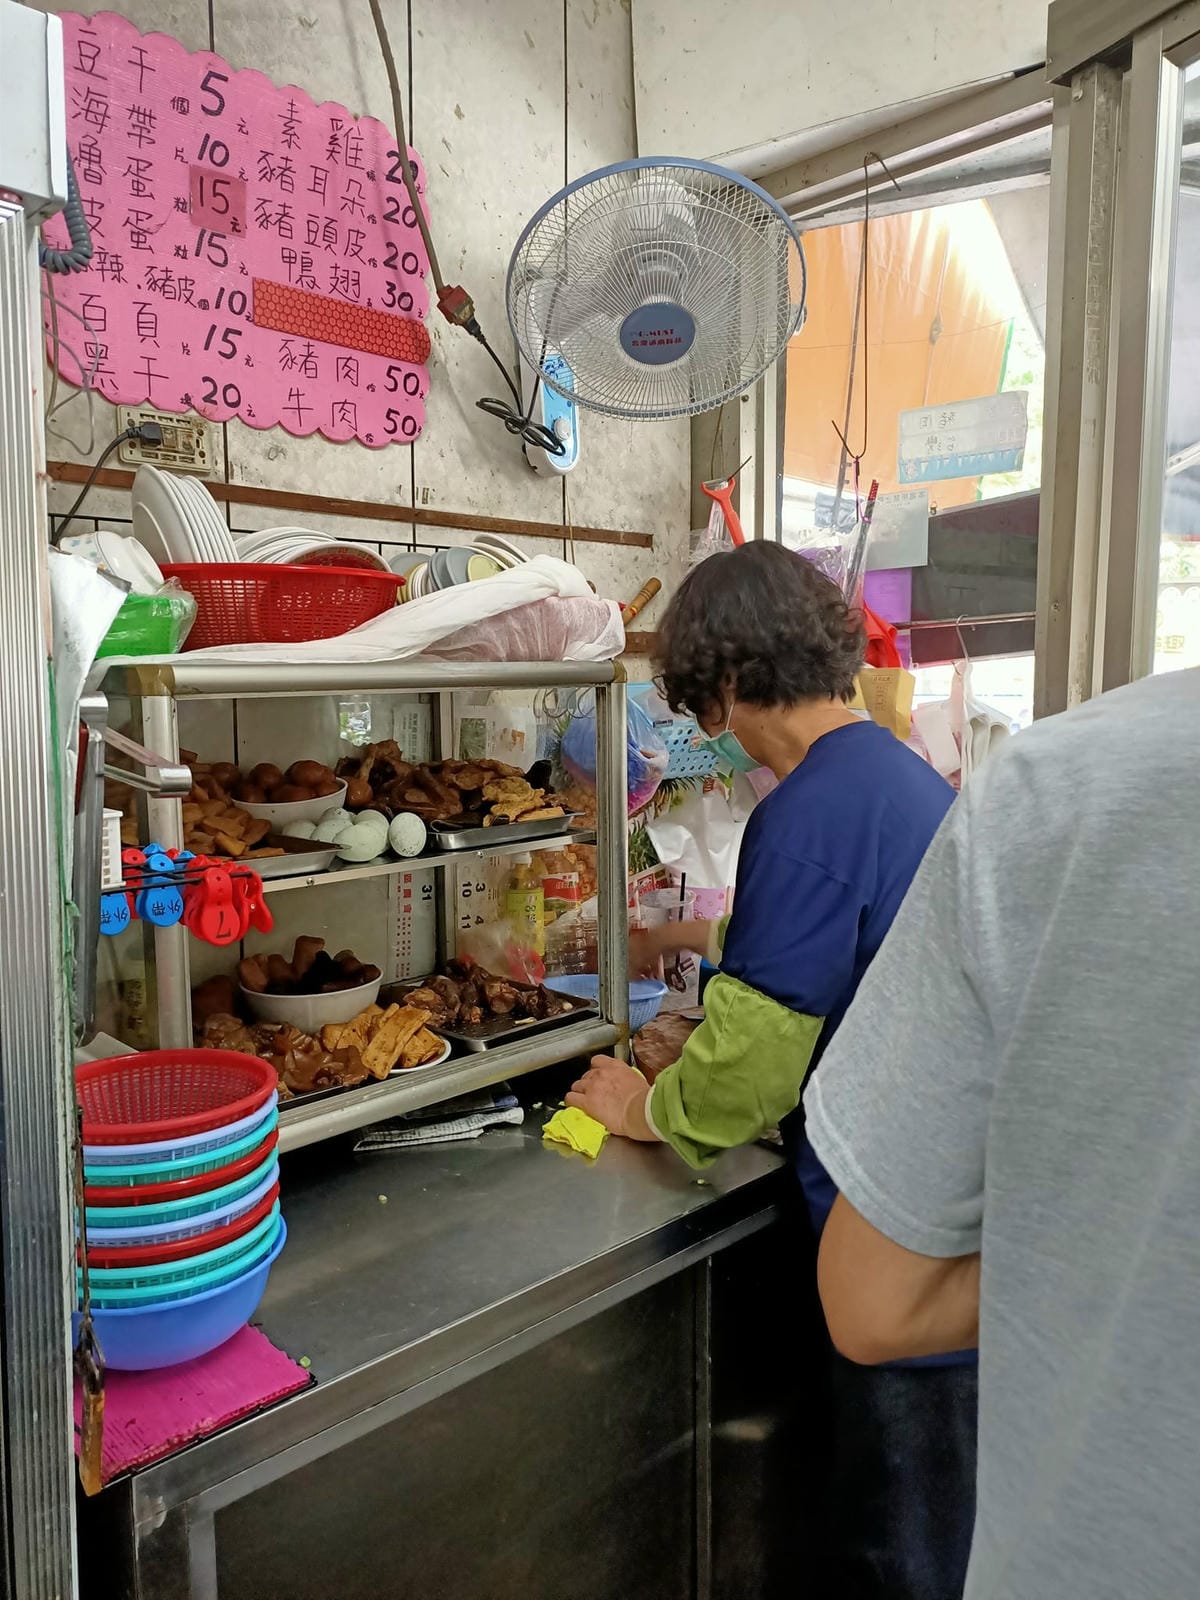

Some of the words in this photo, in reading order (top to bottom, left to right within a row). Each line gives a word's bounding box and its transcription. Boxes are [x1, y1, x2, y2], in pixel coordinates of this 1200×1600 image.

[73, 28, 156, 93] 豆干
[200, 70, 229, 117] 5
[72, 87, 157, 148] 海帶
[198, 133, 230, 167] 10
[278, 99, 366, 171] 素雞
[199, 175, 231, 215] 15
[257, 150, 367, 218] 豬耳朵
[382, 196, 418, 228] 20
[80, 197, 155, 254] 皮蛋
[194, 228, 229, 268] 15
[254, 197, 367, 265] 豬頭皮
[382, 241, 419, 275] 20
[214, 286, 248, 316] 10
[281, 247, 361, 303] 鴨翅
[381, 281, 414, 312] 30
[79, 293, 160, 349] 百頁
[203, 323, 243, 360] 15
[83, 341, 169, 398] 黑干
[201, 375, 242, 409] 20
[278, 339, 360, 388] 豬肉
[384, 365, 420, 396] 50
[281, 387, 358, 433] 牛肉
[383, 408, 417, 437] 50
[152, 899, 180, 917] 外帶
[421, 884, 433, 902] 31
[461, 881, 472, 898] 10
[475, 882, 486, 893] 3
[461, 913, 472, 929] 11
[475, 914, 485, 926] 4
